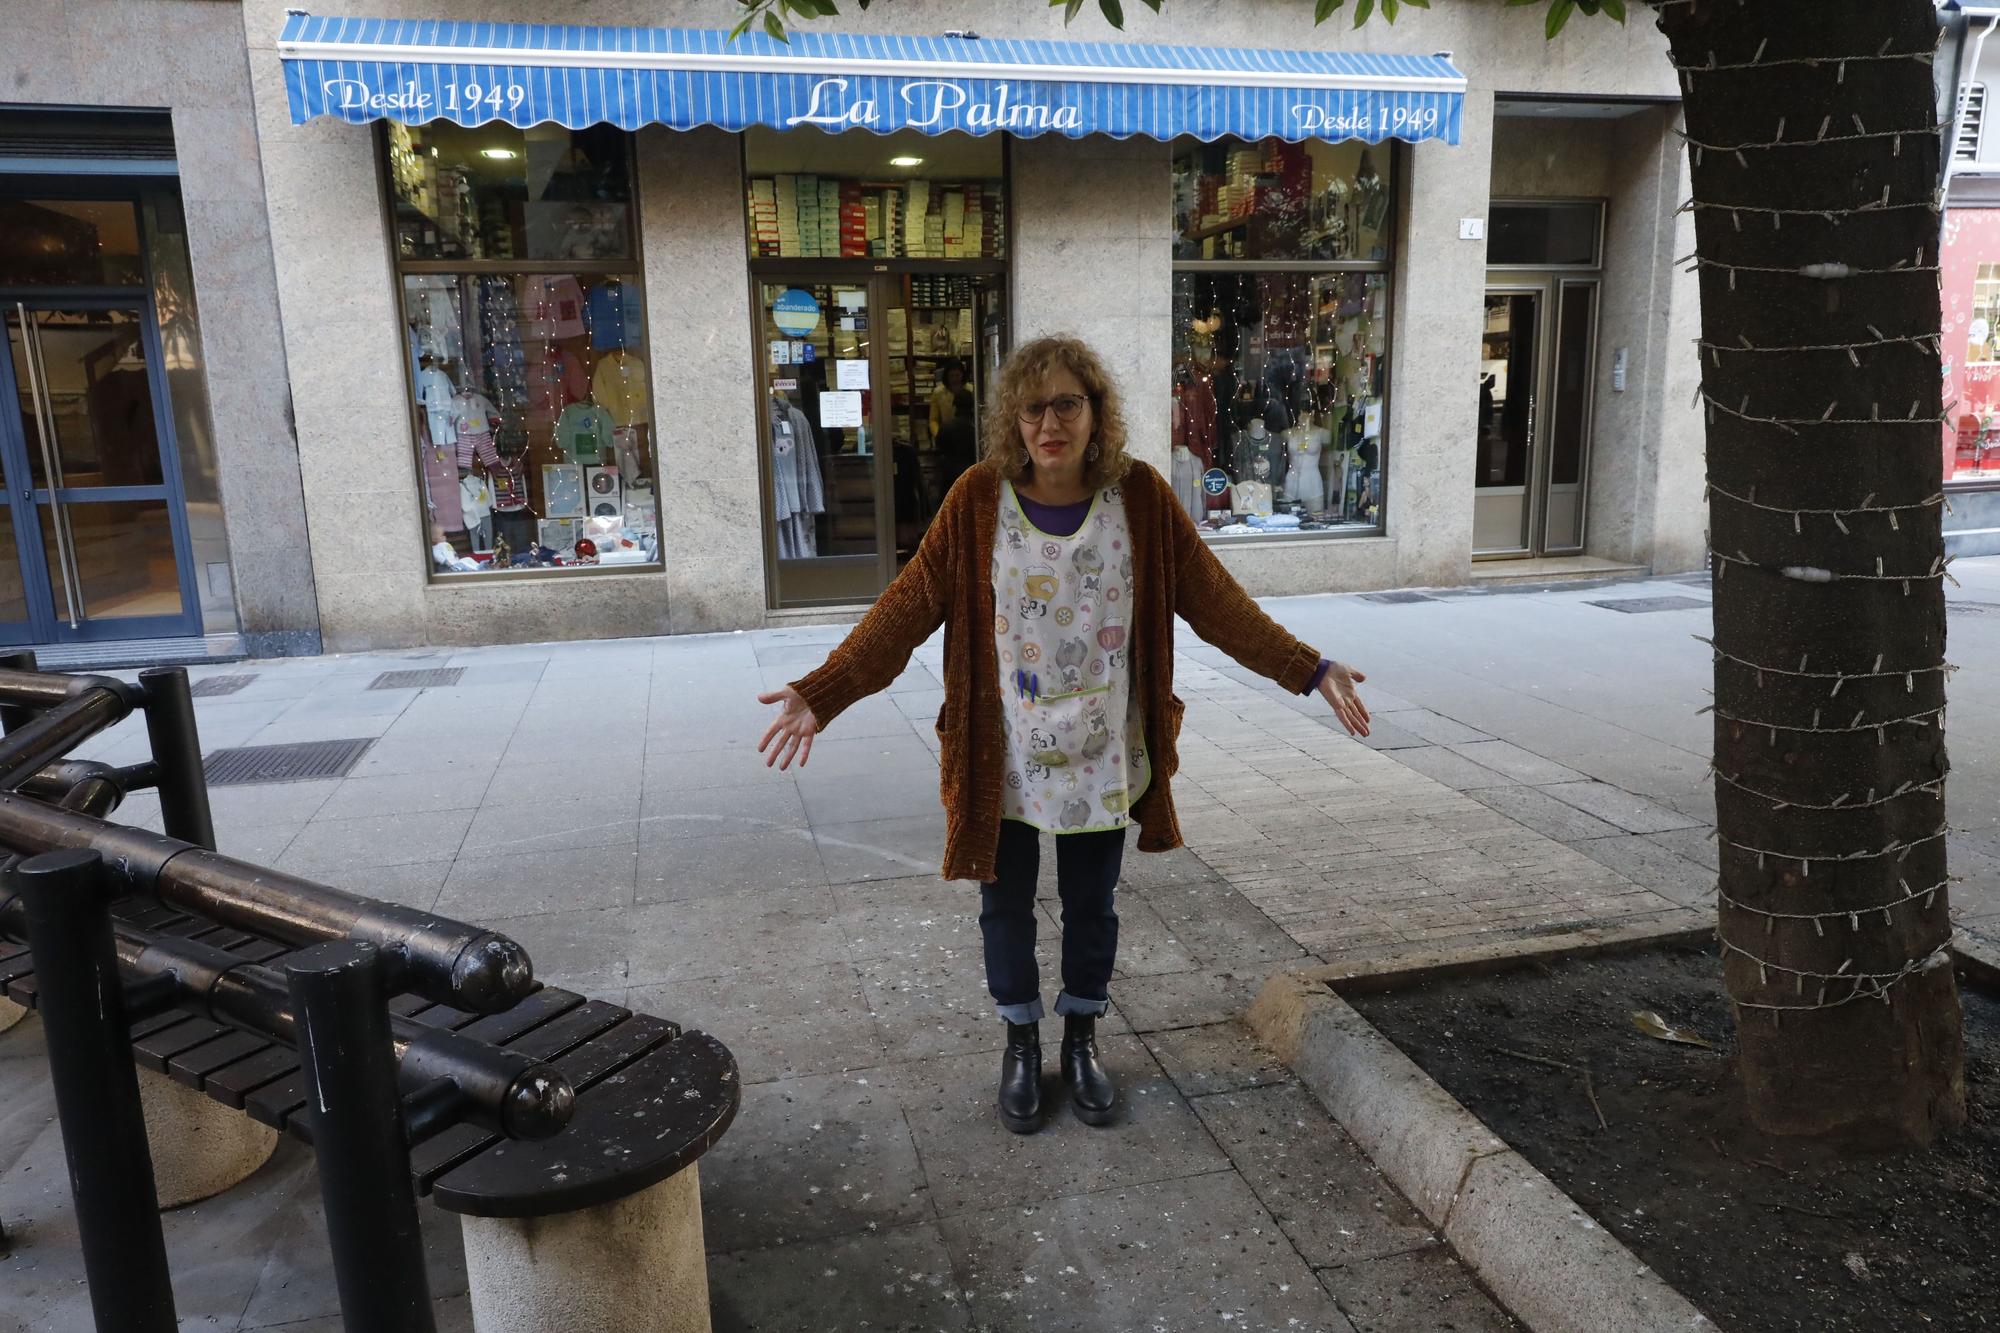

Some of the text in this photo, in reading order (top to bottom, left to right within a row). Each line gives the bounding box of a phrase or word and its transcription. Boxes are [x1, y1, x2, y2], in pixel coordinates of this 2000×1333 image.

[324, 79, 525, 112] Desde 1949
[786, 78, 1083, 129] La Palma
[1291, 104, 1438, 131] Desde 1949
[777, 303, 816, 312] abanderado
